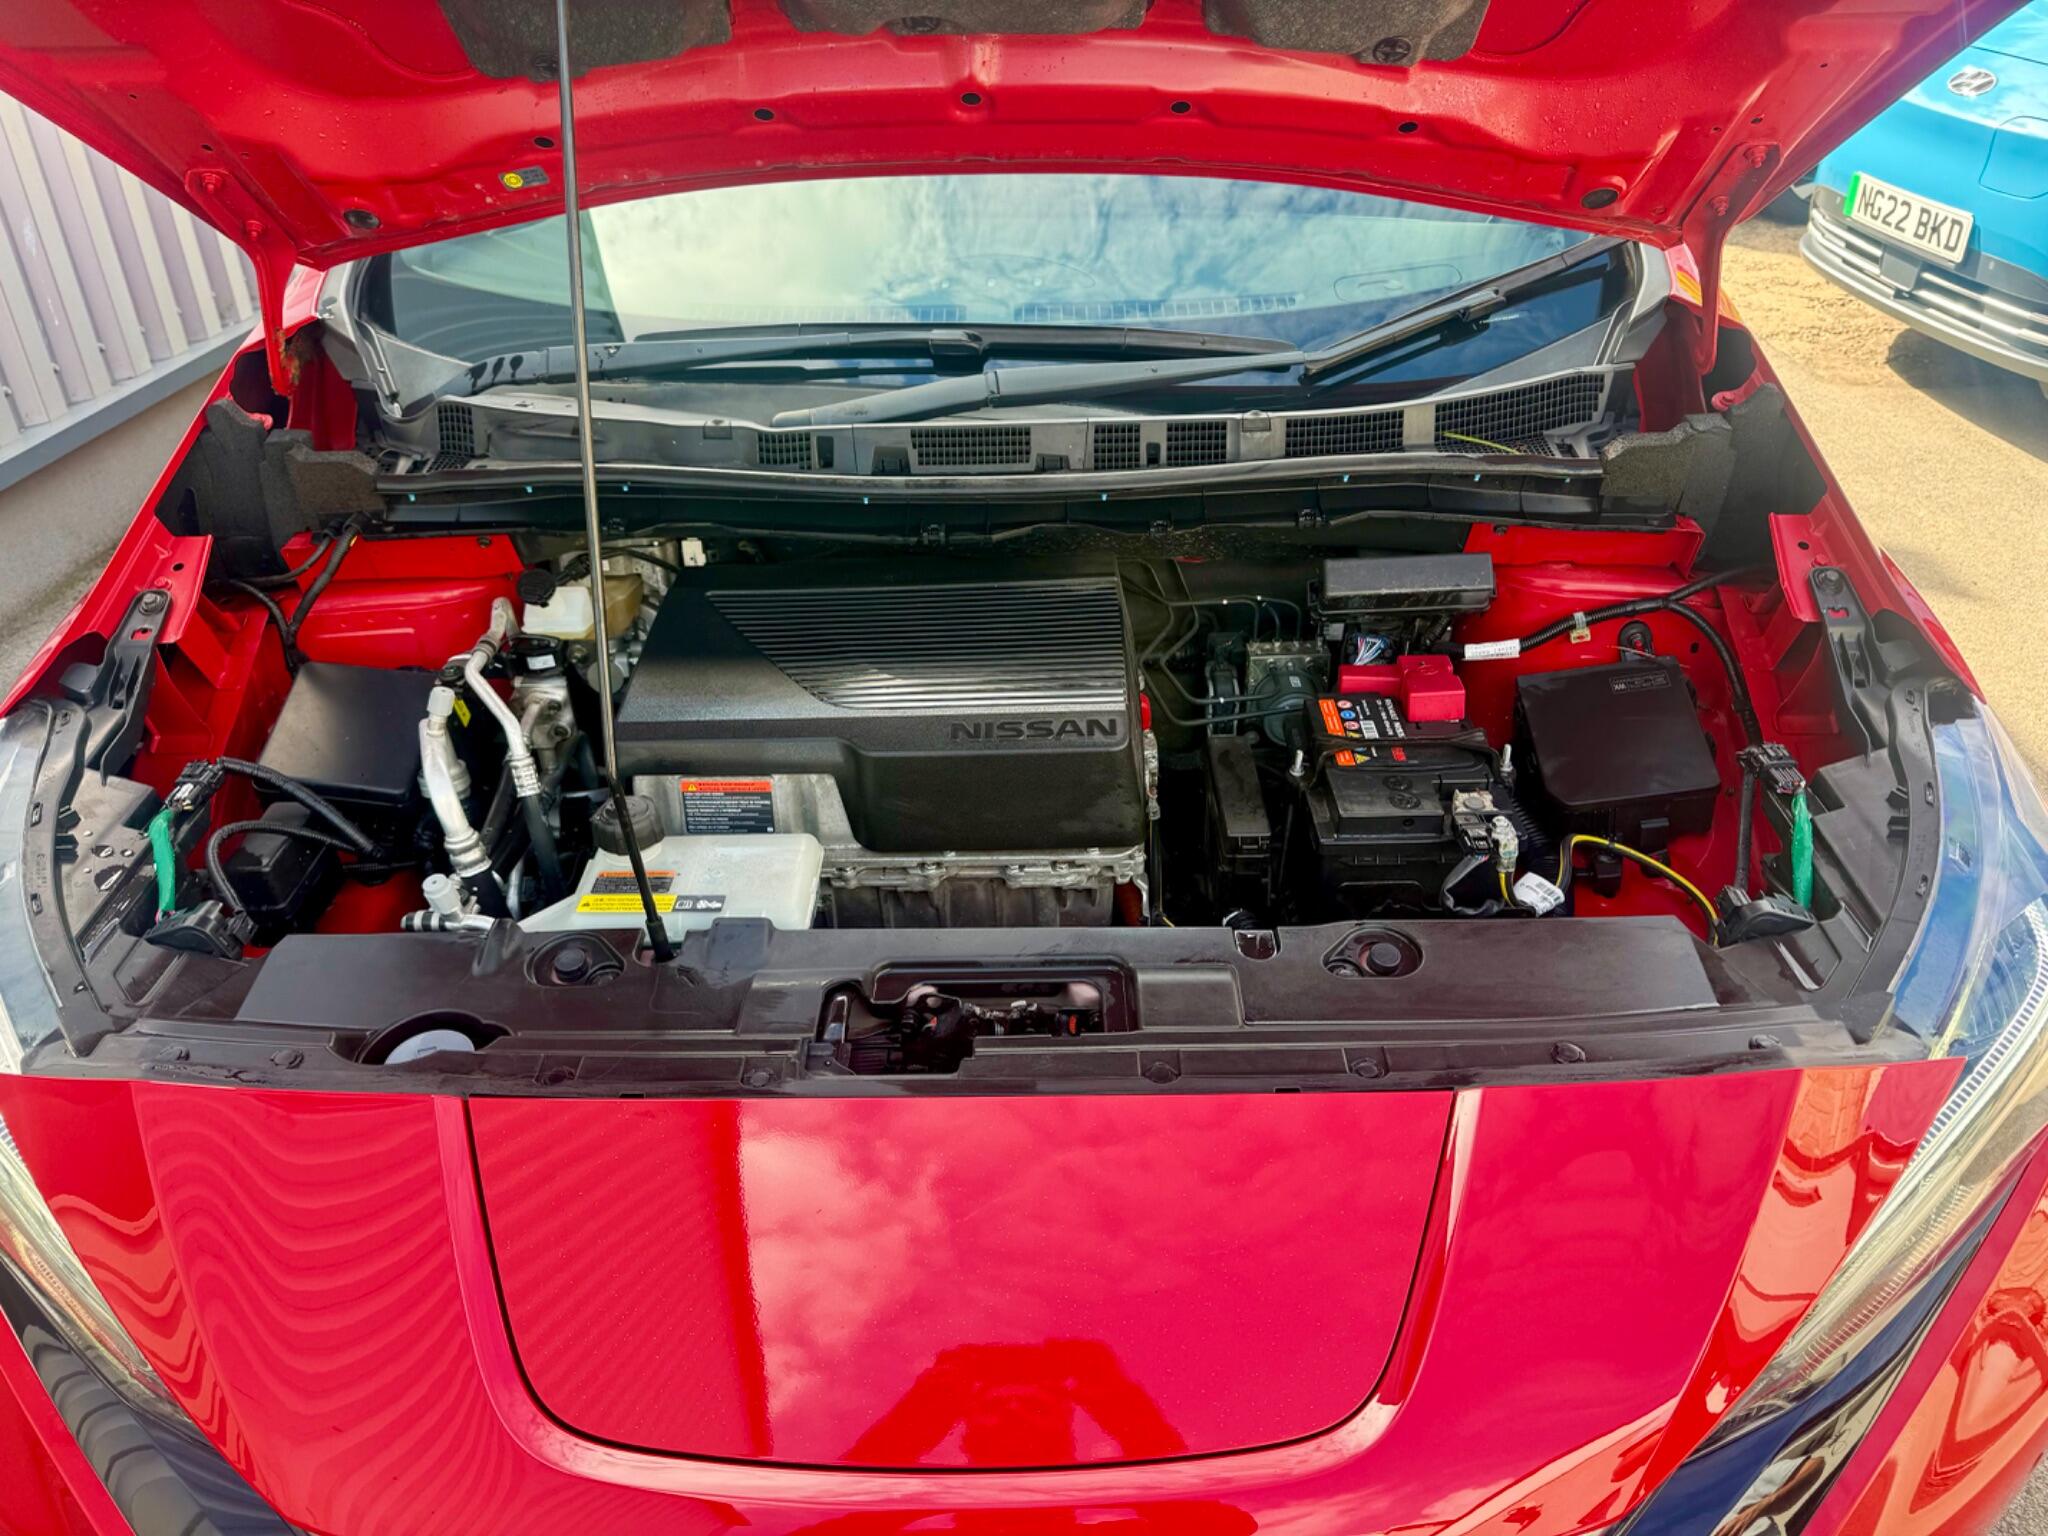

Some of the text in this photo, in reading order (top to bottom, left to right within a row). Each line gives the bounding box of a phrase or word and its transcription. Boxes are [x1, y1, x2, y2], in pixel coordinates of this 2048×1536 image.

[1857, 183, 1964, 252] NG22 BKD
[951, 718, 1118, 740] NISSAN
